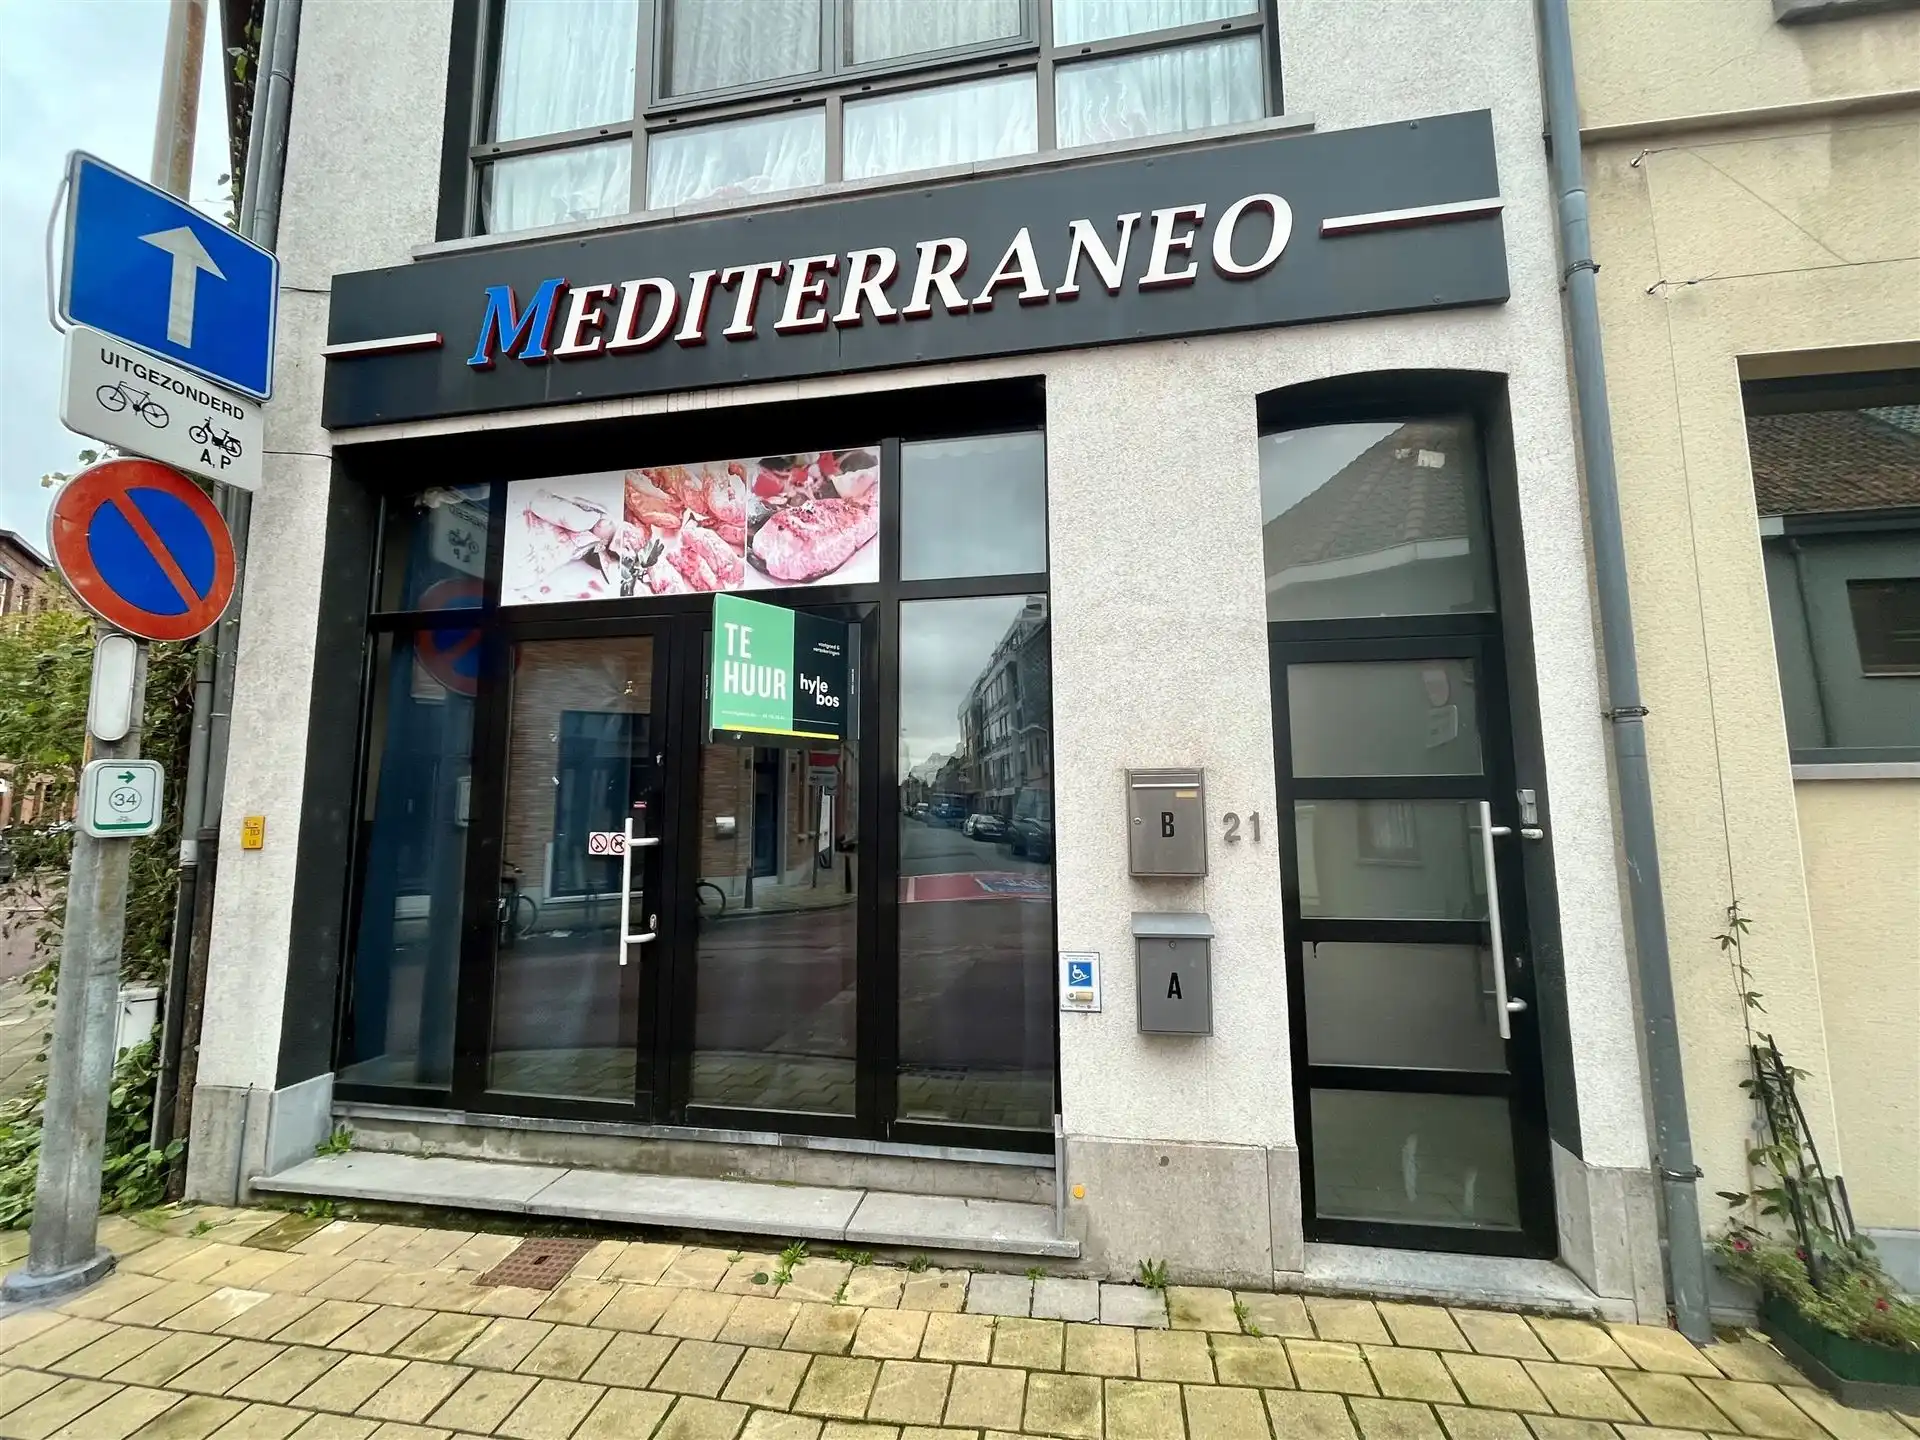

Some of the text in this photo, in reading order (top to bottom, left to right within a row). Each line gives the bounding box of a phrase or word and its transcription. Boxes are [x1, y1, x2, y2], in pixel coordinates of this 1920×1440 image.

[466, 193, 1293, 369] MEDITERRANEO
[100, 348, 245, 421] UITGEZONDERD
[200, 448, 231, 470] A, P
[724, 622, 753, 659] TE
[723, 660, 786, 701] HUUR
[799, 673, 829, 695] hyle
[816, 688, 840, 708] bos
[113, 793, 137, 807] 34
[1161, 811, 1175, 838] B
[1222, 811, 1261, 843] 21
[1167, 972, 1183, 1000] A
